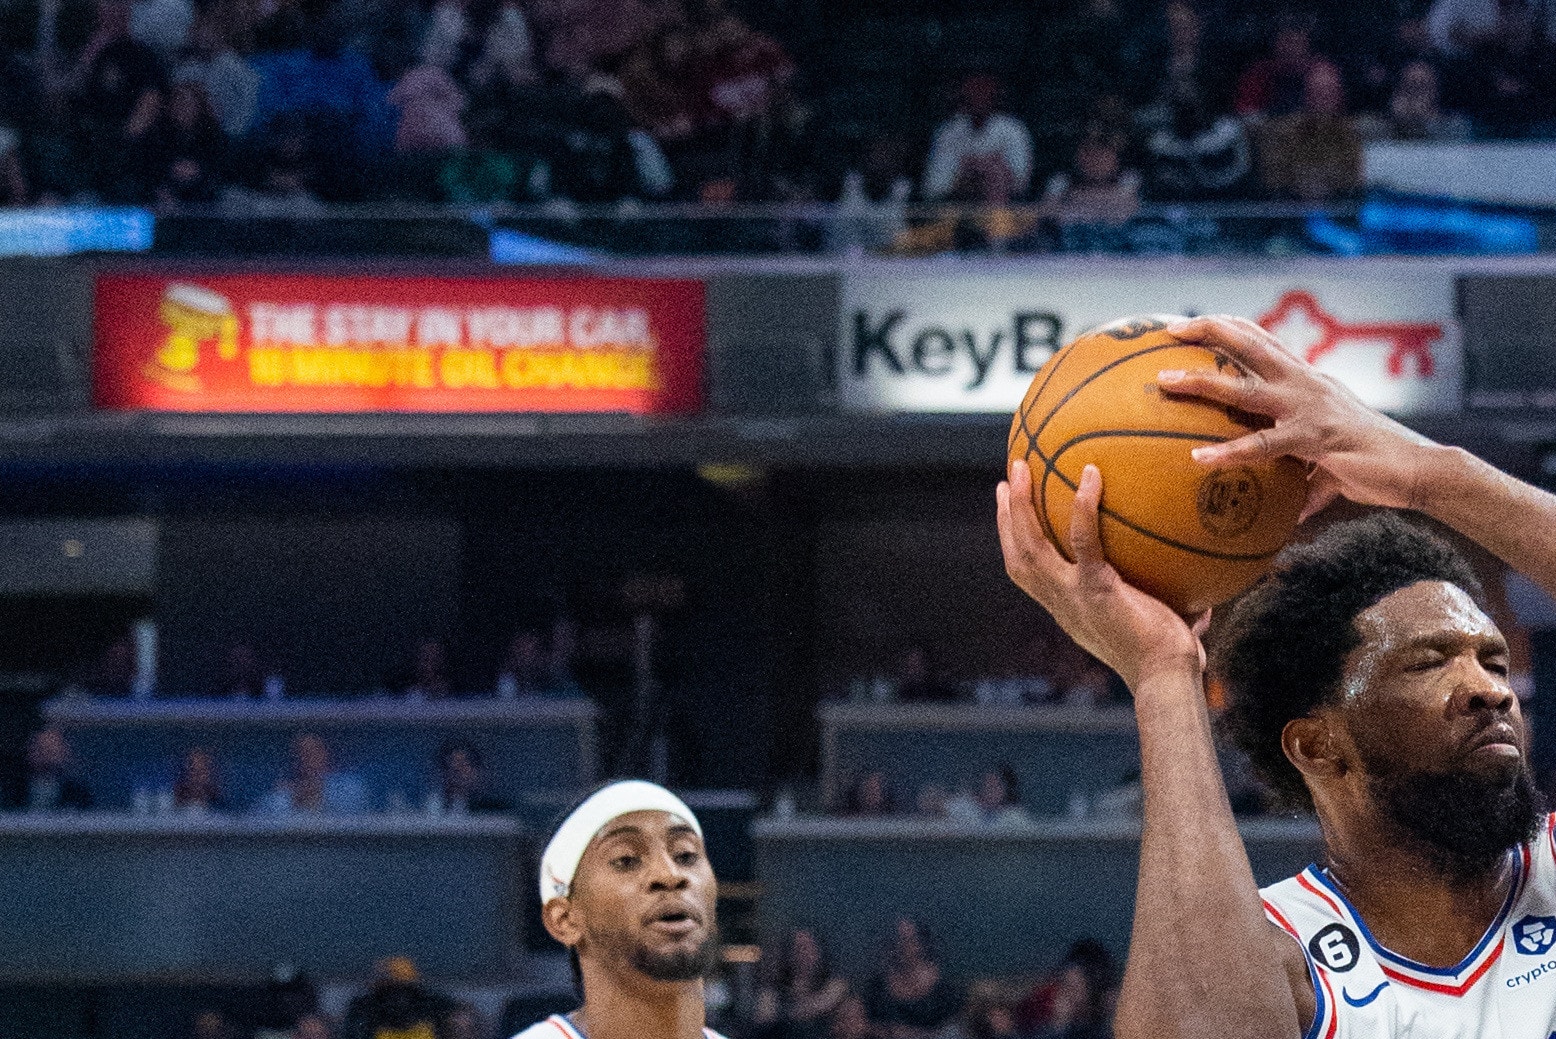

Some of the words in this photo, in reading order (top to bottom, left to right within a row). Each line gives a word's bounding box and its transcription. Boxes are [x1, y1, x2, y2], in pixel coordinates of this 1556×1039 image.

[249, 302, 315, 345] THE
[325, 302, 413, 345] STAY
[416, 303, 463, 346] IN
[467, 304, 564, 346] YOUR
[1318, 930, 1353, 968] 6
